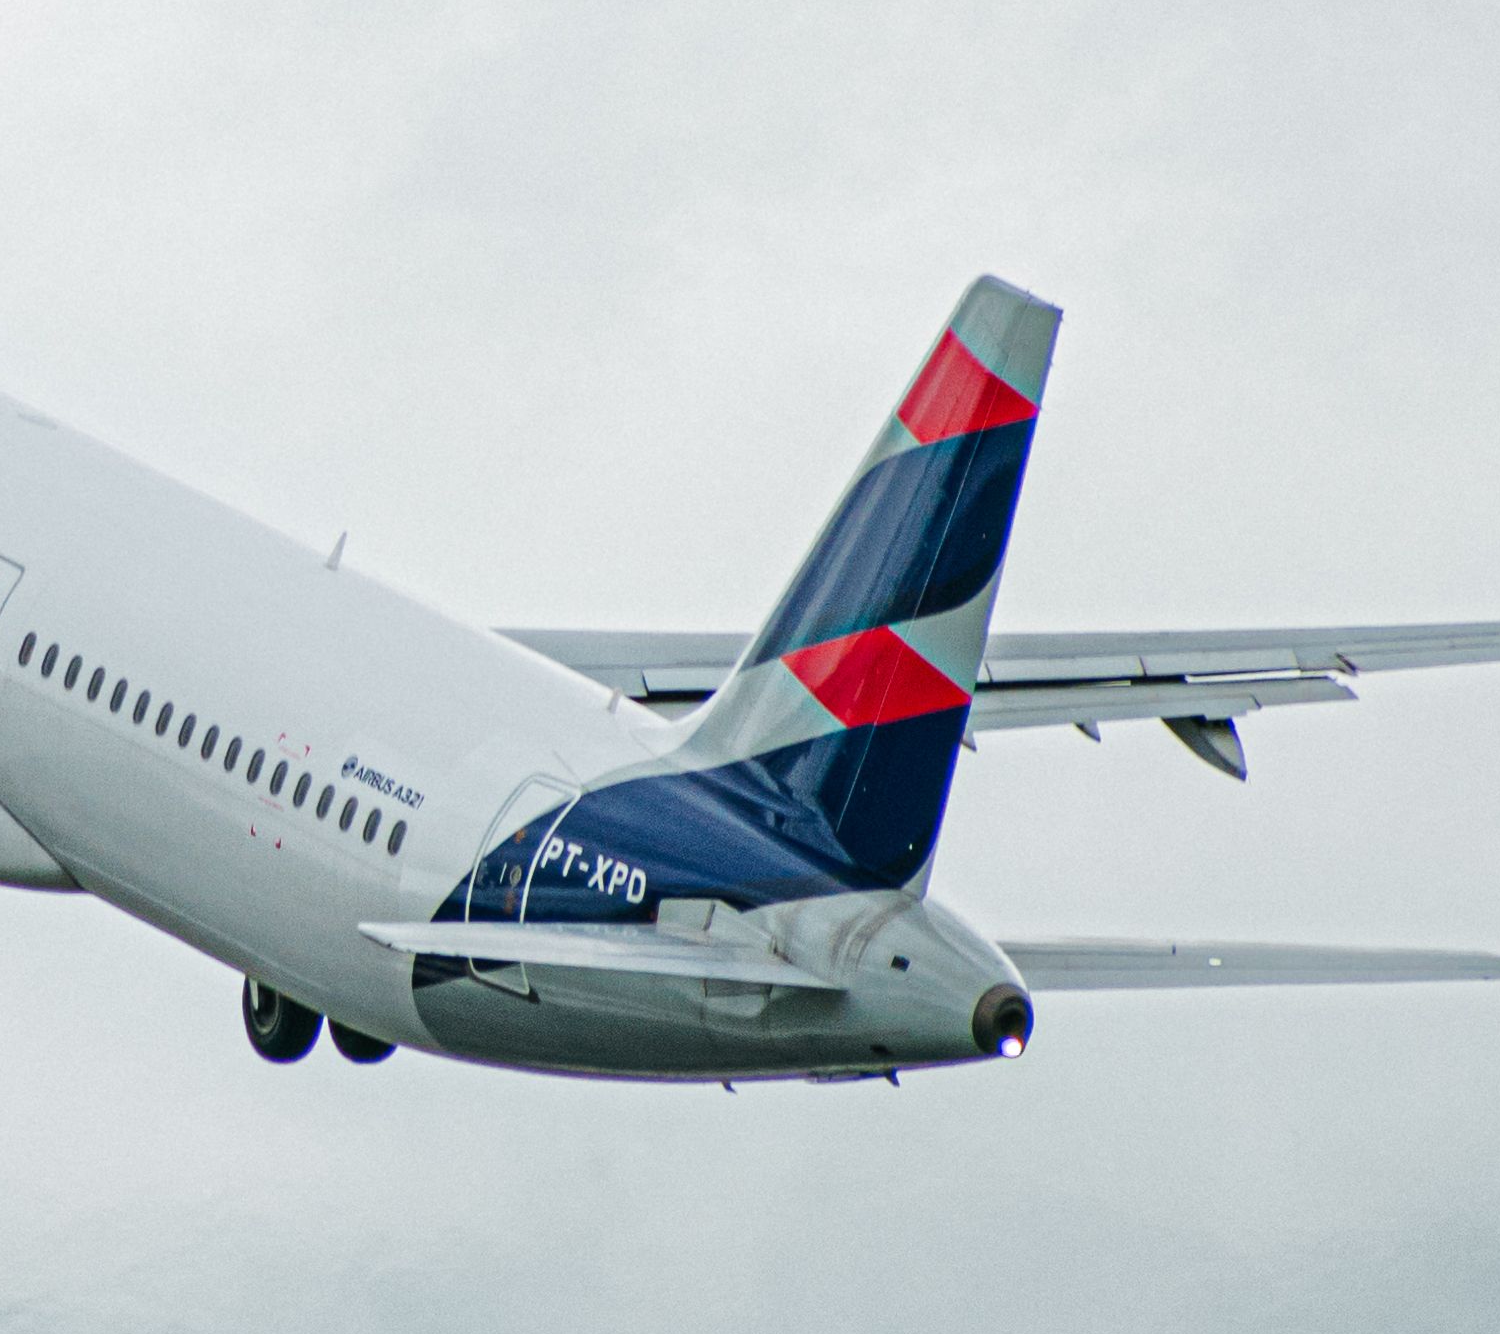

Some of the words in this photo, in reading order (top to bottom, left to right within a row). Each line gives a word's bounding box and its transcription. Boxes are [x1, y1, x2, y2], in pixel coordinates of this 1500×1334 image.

[354, 764, 395, 794] AIRBUS
[393, 784, 425, 810] A321
[540, 836, 647, 904] PT-XPD
